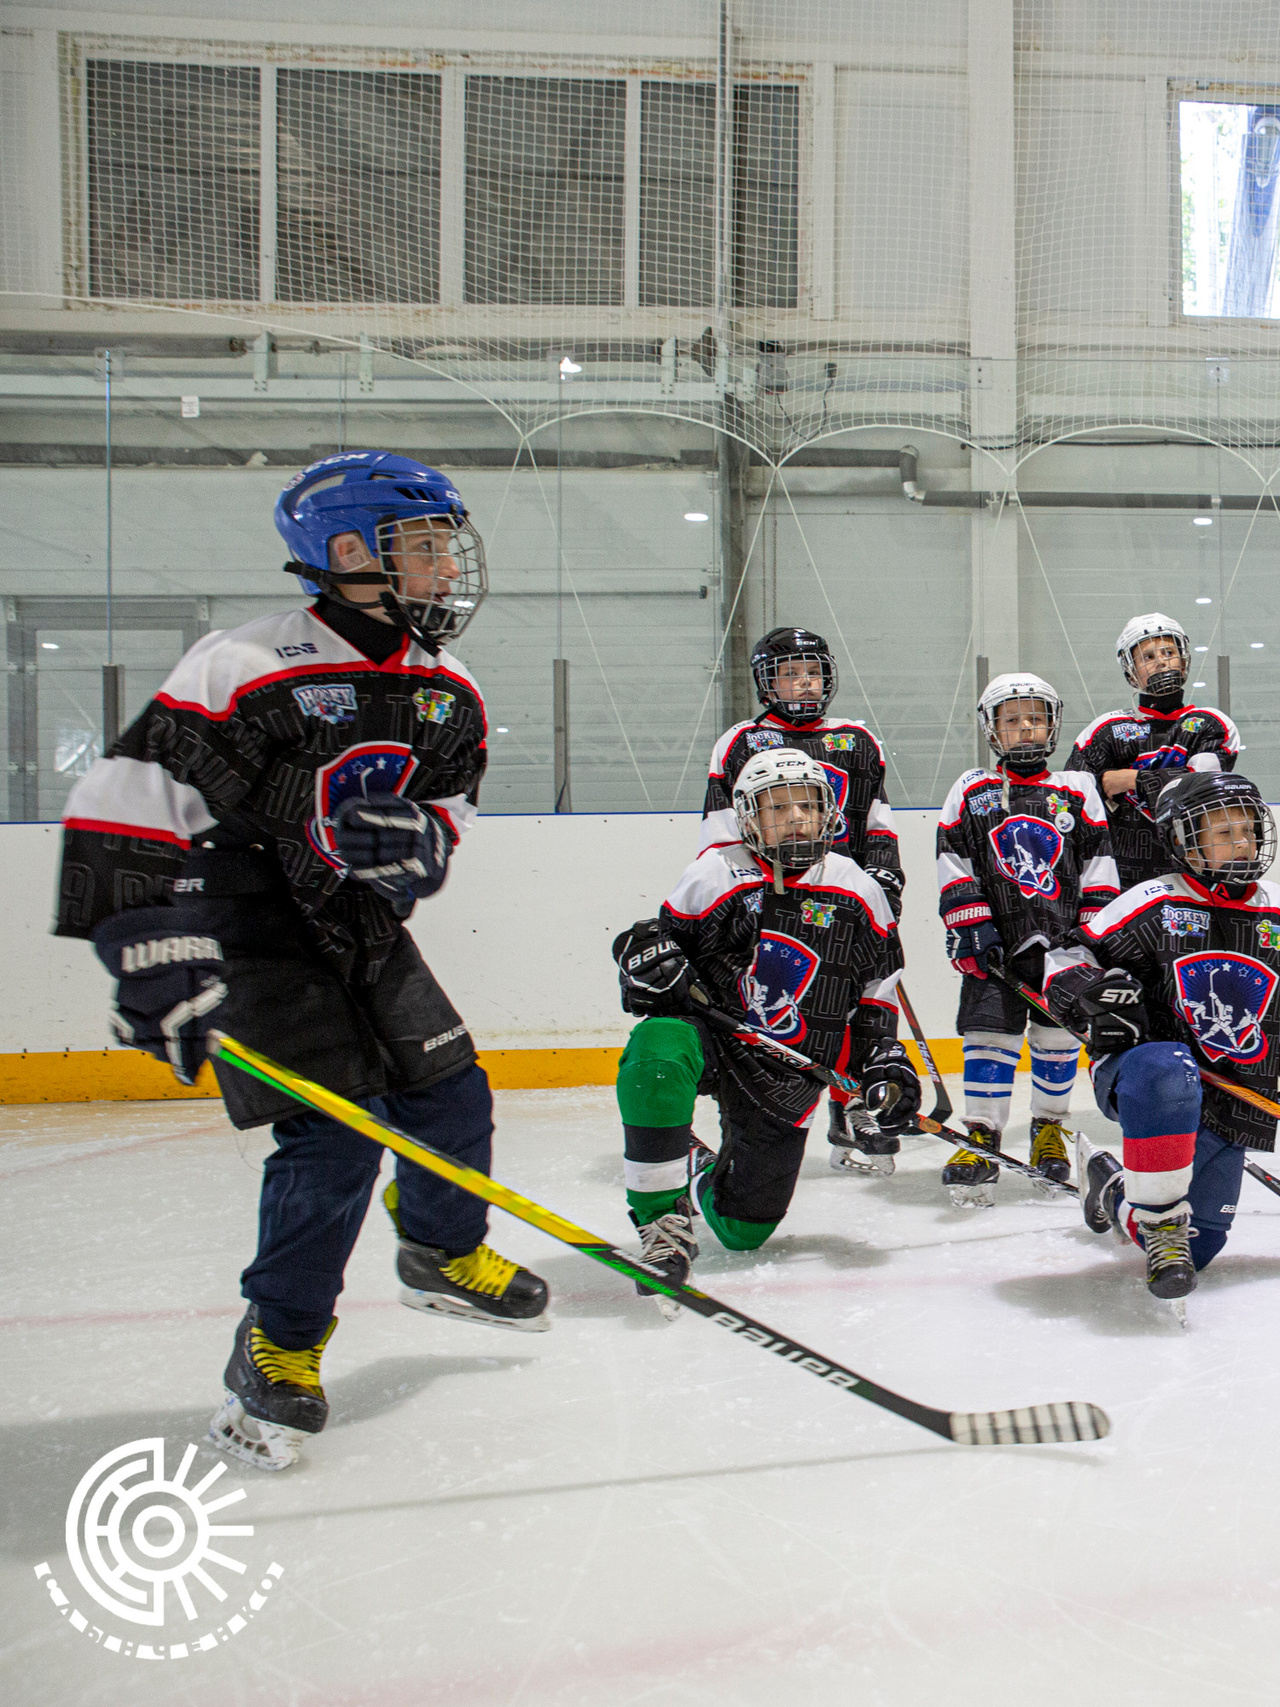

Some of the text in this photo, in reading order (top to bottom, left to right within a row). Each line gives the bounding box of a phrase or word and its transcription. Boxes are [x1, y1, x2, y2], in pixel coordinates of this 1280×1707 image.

[776, 760, 806, 768] CCM
[1098, 988, 1142, 1004] STX
[711, 1311, 861, 1390] BAUER
